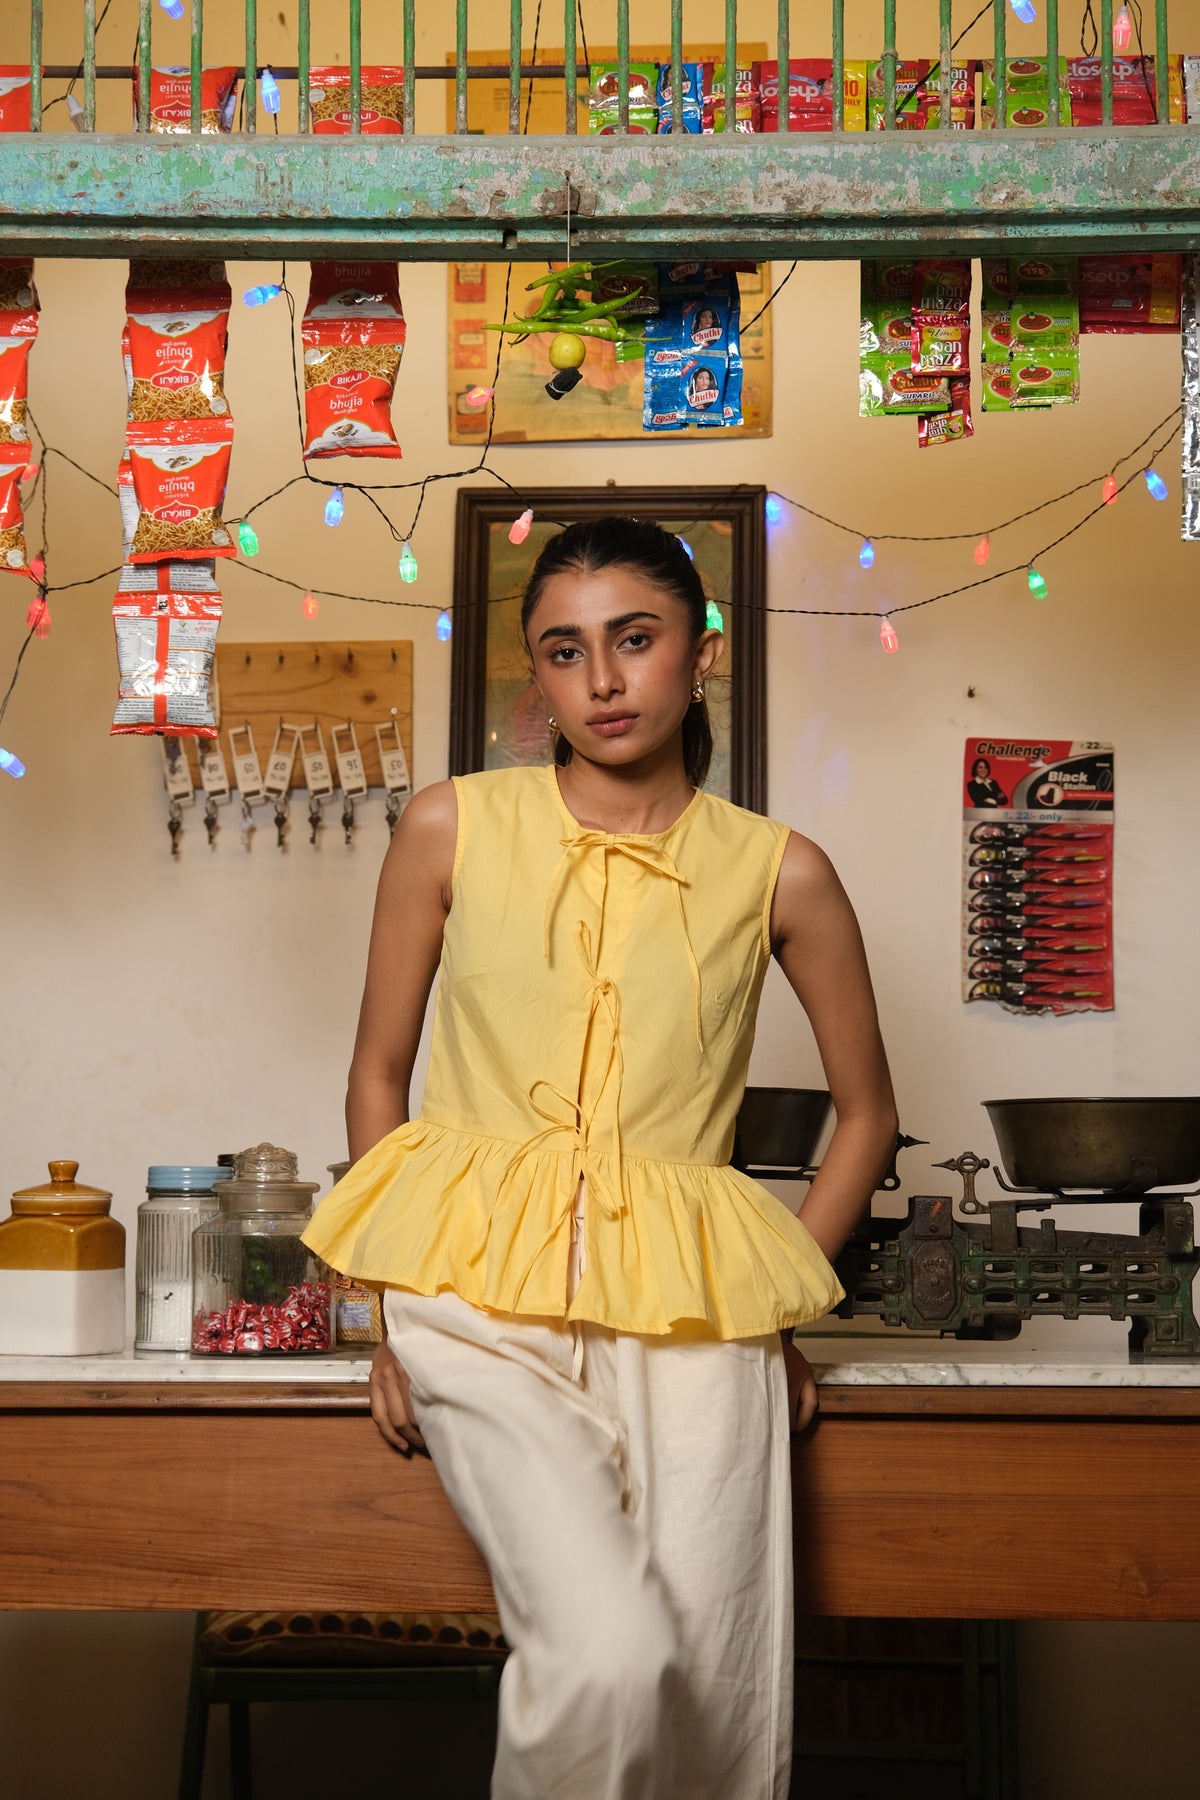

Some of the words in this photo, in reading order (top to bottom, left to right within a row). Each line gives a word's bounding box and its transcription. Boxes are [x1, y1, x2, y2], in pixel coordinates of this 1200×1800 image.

[736, 70, 752, 80] an
[951, 69, 968, 79] an
[1068, 63, 1133, 80] losup
[160, 83, 191, 95] hujia
[712, 80, 752, 93] mza
[925, 80, 968, 92] mza
[759, 83, 820, 103] loeup
[334, 265, 372, 280] bhujia
[693, 329, 721, 342] Chutki
[155, 347, 193, 359] bhujia
[160, 375, 189, 384] BIKAJI
[336, 373, 363, 385] BIKAJI
[329, 396, 363, 411] bhujia
[690, 391, 718, 404] Chutki
[158, 481, 195, 494] bhujia
[161, 509, 191, 519] BIKAJI
[976, 742, 1051, 760] Challenge
[1047, 771, 1088, 783] Black
[1063, 783, 1097, 791] Stallion
[1039, 812, 1063, 822] only
